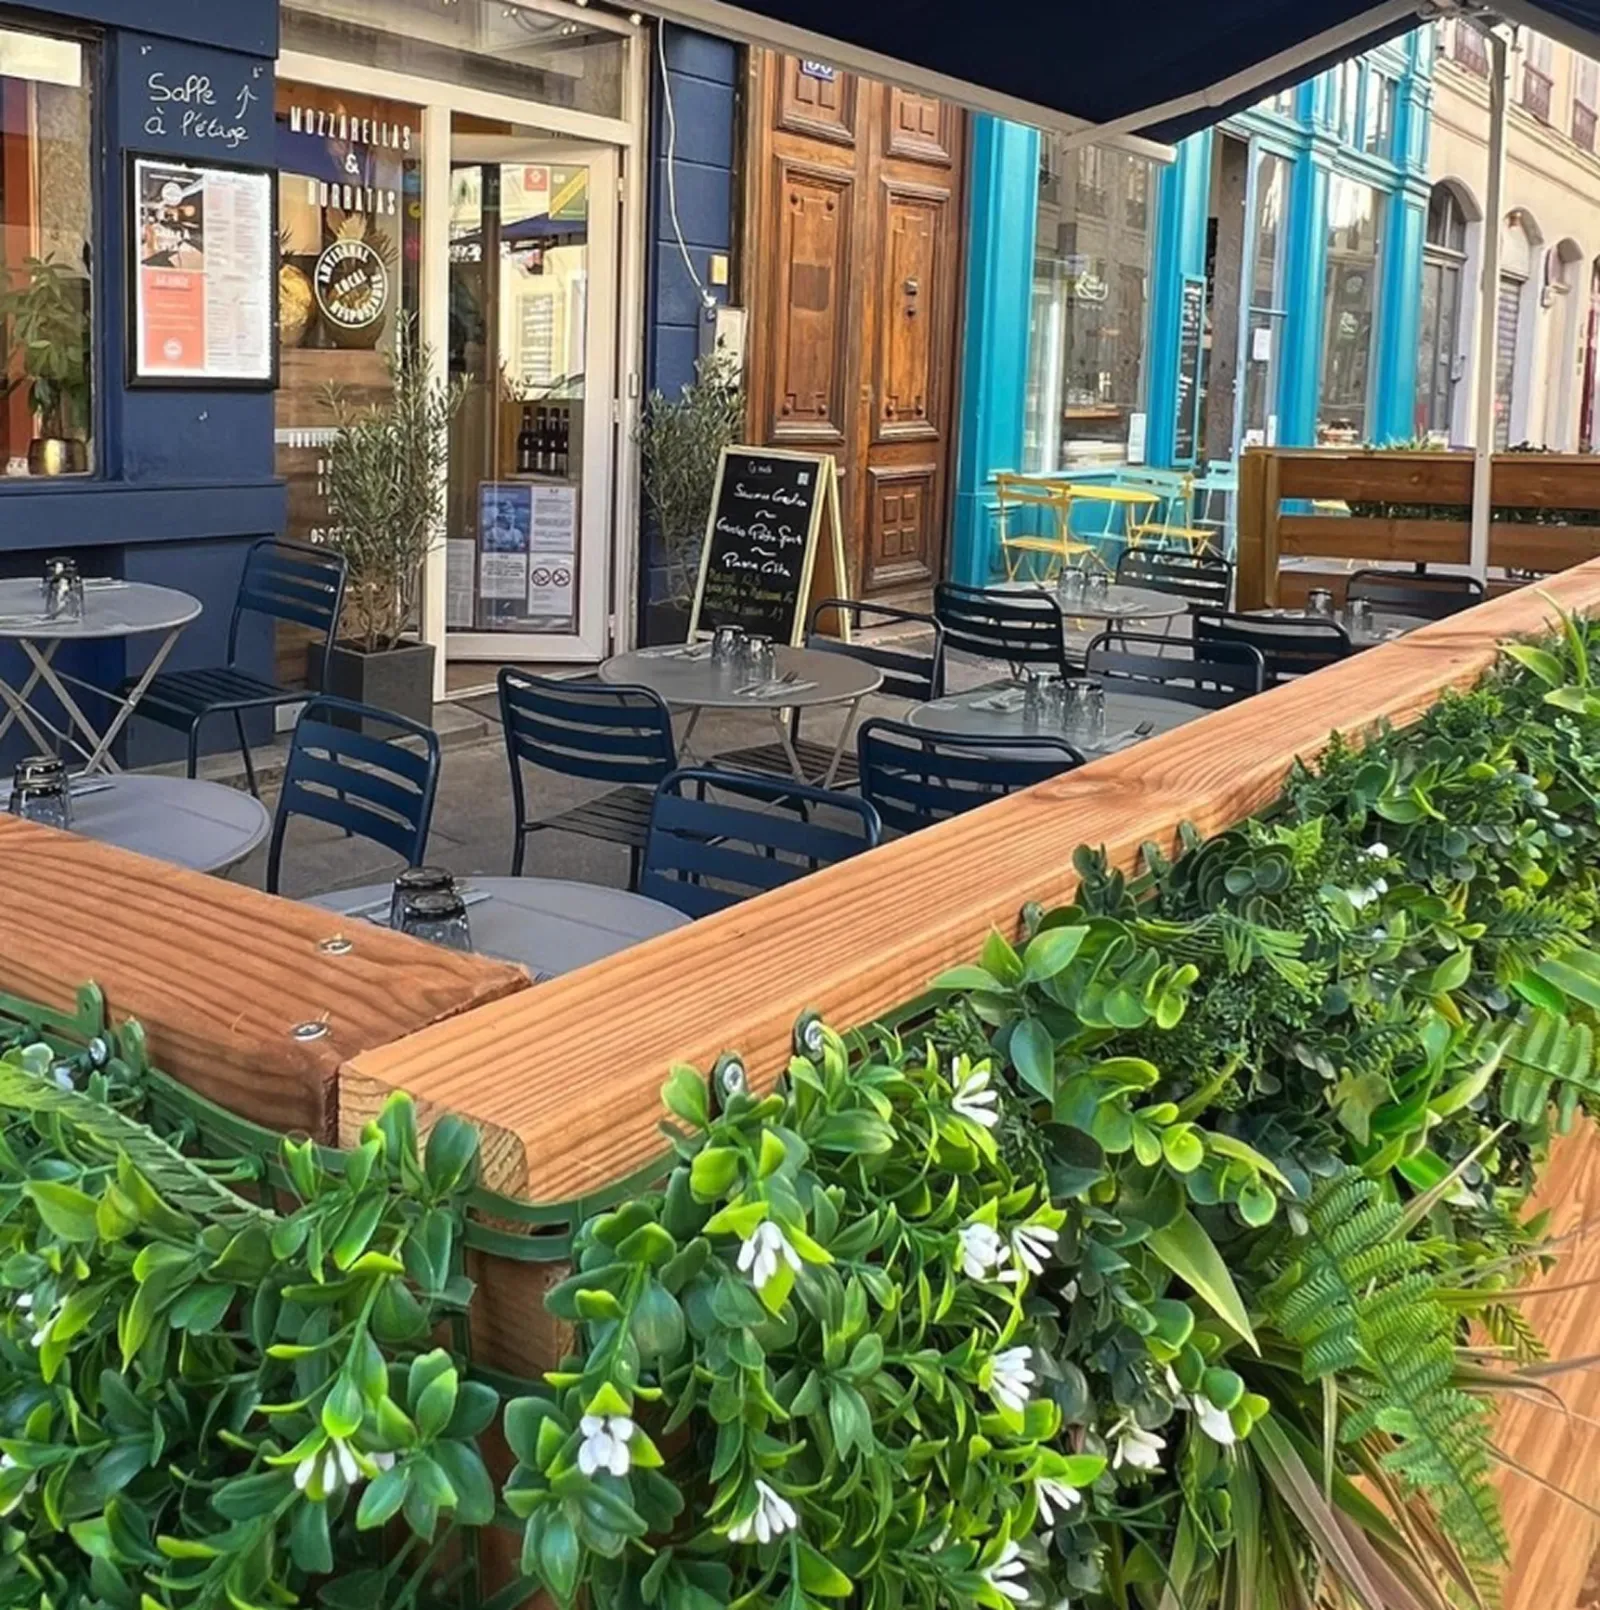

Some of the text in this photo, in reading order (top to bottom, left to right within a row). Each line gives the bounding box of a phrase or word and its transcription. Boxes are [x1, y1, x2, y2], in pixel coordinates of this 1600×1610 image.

[148, 72, 217, 105] Salle
[144, 107, 249, 148] à l'étage
[290, 105, 411, 151] MOZZARELLAS
[345, 153, 360, 175] &
[334, 269, 367, 296] LOCAL
